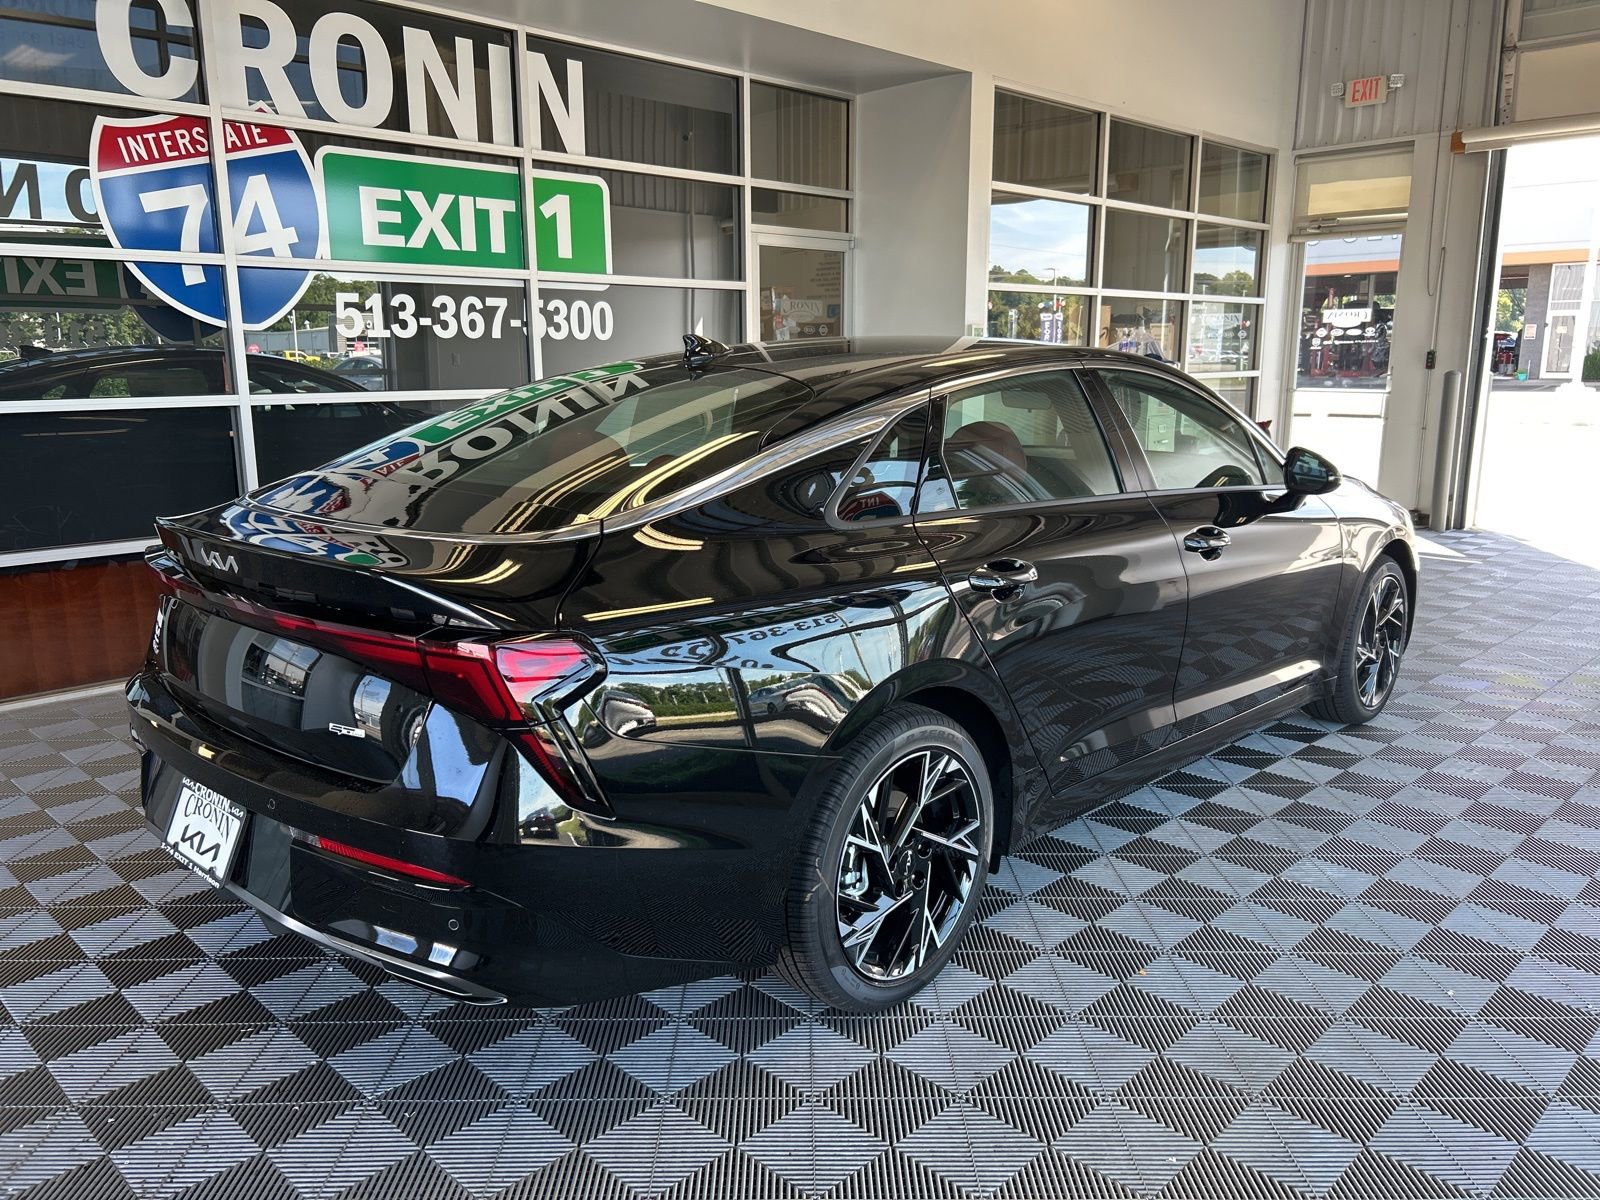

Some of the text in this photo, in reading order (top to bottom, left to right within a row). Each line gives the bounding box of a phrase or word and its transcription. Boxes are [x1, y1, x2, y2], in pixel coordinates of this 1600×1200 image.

[95, 0, 586, 156] CRONIN
[1352, 77, 1382, 102] EXIT
[117, 122, 268, 164] INTERSATE
[139, 174, 298, 287] 74
[358, 185, 573, 259] EXIT 1
[335, 292, 614, 341] 513-367-5300
[184, 793, 235, 844] CRONIN
[194, 782, 231, 812] CRONIN
[193, 865, 220, 889] Harrison
